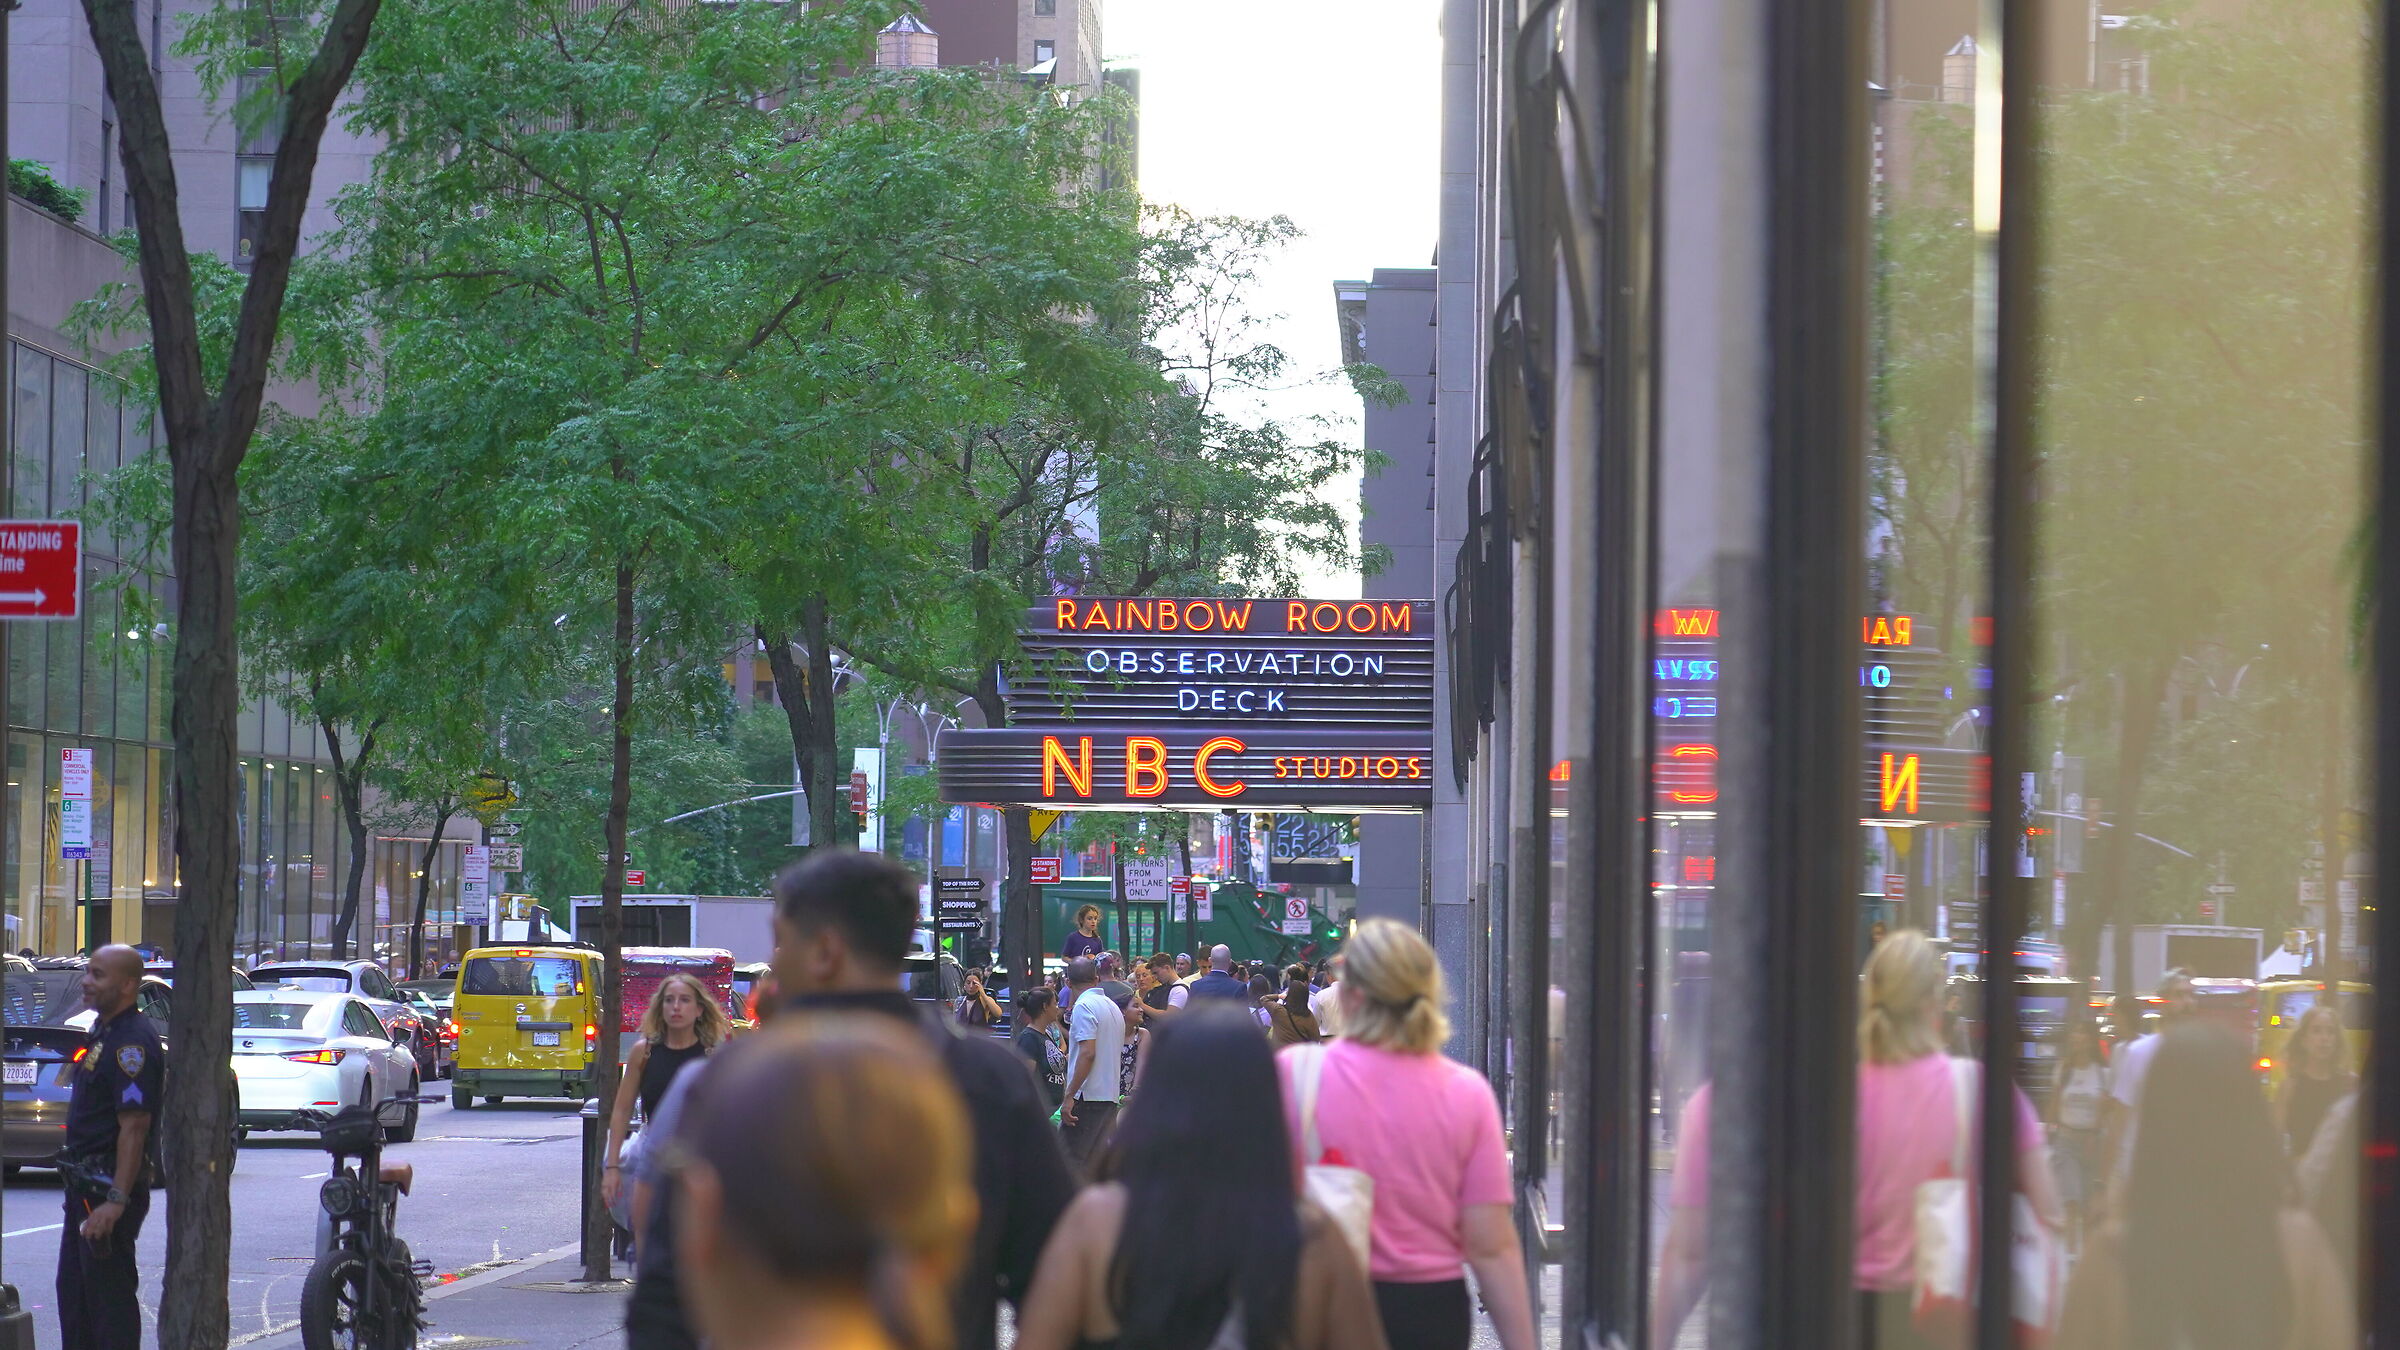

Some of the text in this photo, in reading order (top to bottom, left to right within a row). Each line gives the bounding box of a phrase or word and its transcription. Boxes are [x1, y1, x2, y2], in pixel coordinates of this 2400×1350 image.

[0, 531, 62, 551] TANDING
[0, 554, 25, 573] ime
[1056, 600, 1411, 633] RAINBOW ROOM
[1086, 650, 1383, 677] OBSERVATION
[1178, 689, 1285, 712] DECK
[1042, 736, 1422, 797] NBC STUDIOS
[1123, 859, 1136, 867] GHT
[1129, 869, 1151, 877] FROM
[1124, 879, 1163, 887] GHT LANE
[1129, 888, 1150, 896] ONLY
[942, 901, 977, 909] SHOPPING
[3, 1068, 33, 1079] 122036C
